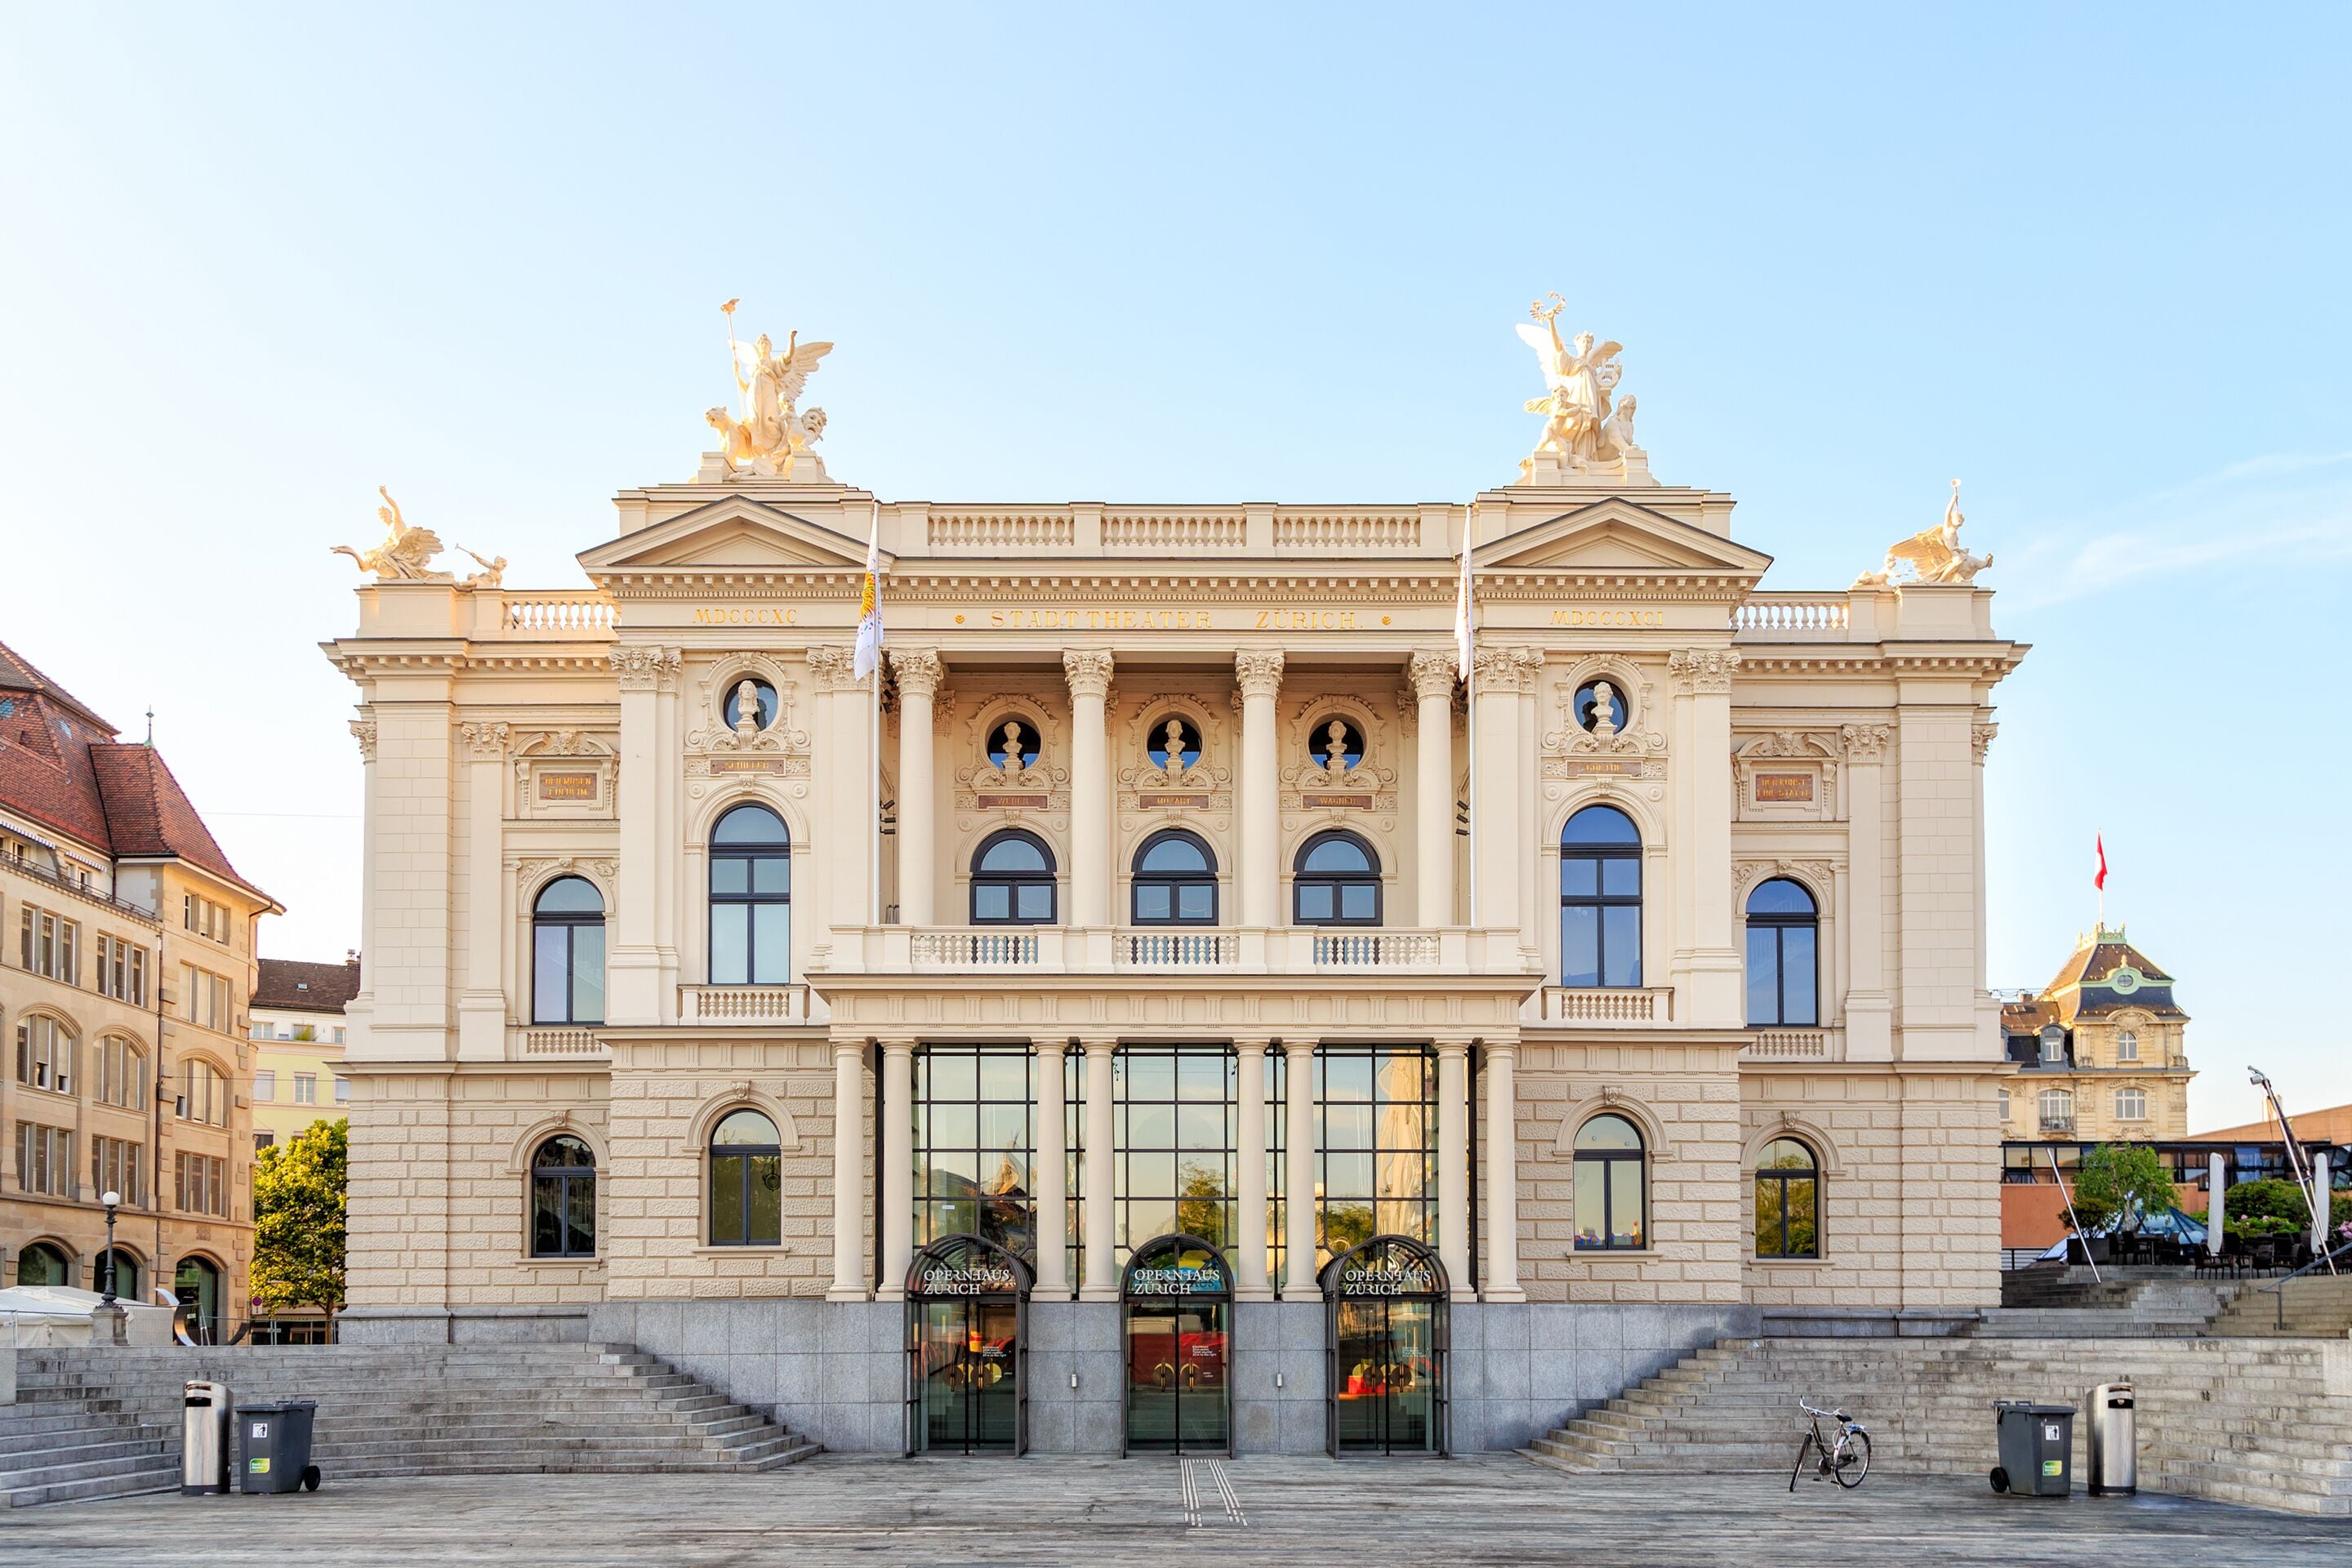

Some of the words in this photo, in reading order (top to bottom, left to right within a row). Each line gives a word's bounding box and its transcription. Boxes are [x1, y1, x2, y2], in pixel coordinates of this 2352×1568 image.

[693, 608, 798, 624] MDCCCXC
[1549, 610, 1664, 626] MDCCCXCI
[924, 1269, 1009, 1281] OPERNHAUS
[1134, 1269, 1220, 1281] OPERNHAUS
[1345, 1270, 1431, 1282] OPERNHAUS
[924, 1281, 981, 1294] ZÜRICH
[1134, 1281, 1192, 1294] ZÜRICH
[1345, 1281, 1402, 1294] ZÜRICH
